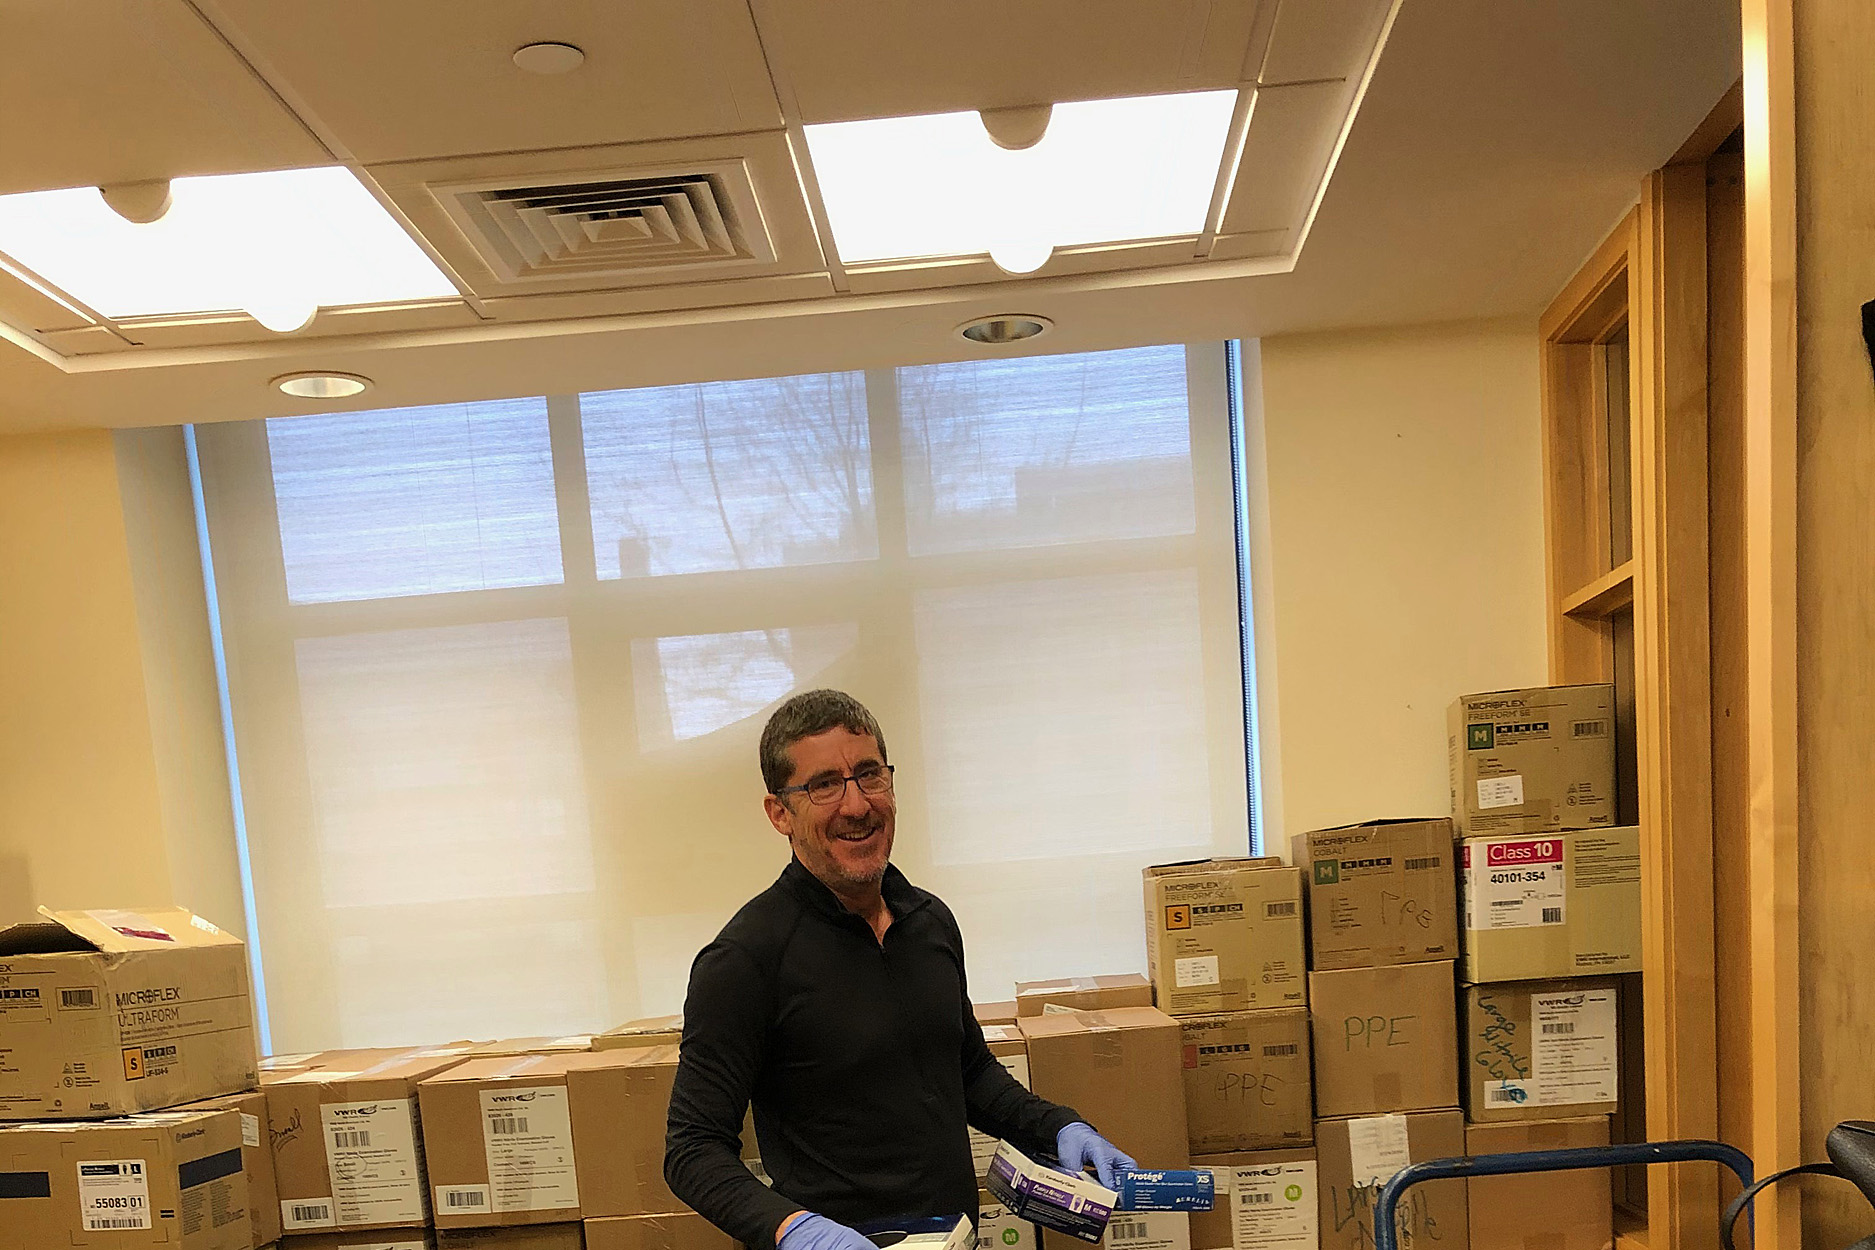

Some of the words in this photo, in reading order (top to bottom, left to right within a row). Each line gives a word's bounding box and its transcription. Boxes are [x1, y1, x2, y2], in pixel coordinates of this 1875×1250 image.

[1468, 700, 1526, 711] MICROFLEX
[1474, 730, 1487, 742] M
[1313, 835, 1368, 848] MICROFLEX
[1314, 847, 1346, 857] COBALT
[1490, 844, 1532, 860] Class
[1535, 842, 1553, 857] 10
[1319, 865, 1333, 878] M
[1490, 871, 1546, 884] 40101-354
[1165, 881, 1219, 892] MICROFLEX
[1174, 911, 1183, 923] S
[116, 987, 181, 1006] MICROFLEX
[118, 1007, 181, 1027] ULTRAFORM
[1344, 1015, 1417, 1052] PPE
[131, 1057, 138, 1071] S
[1127, 1172, 1166, 1183] Protégé
[95, 1197, 128, 1209] 55083
[130, 1196, 143, 1208] 01
[1083, 1203, 1092, 1212] M
